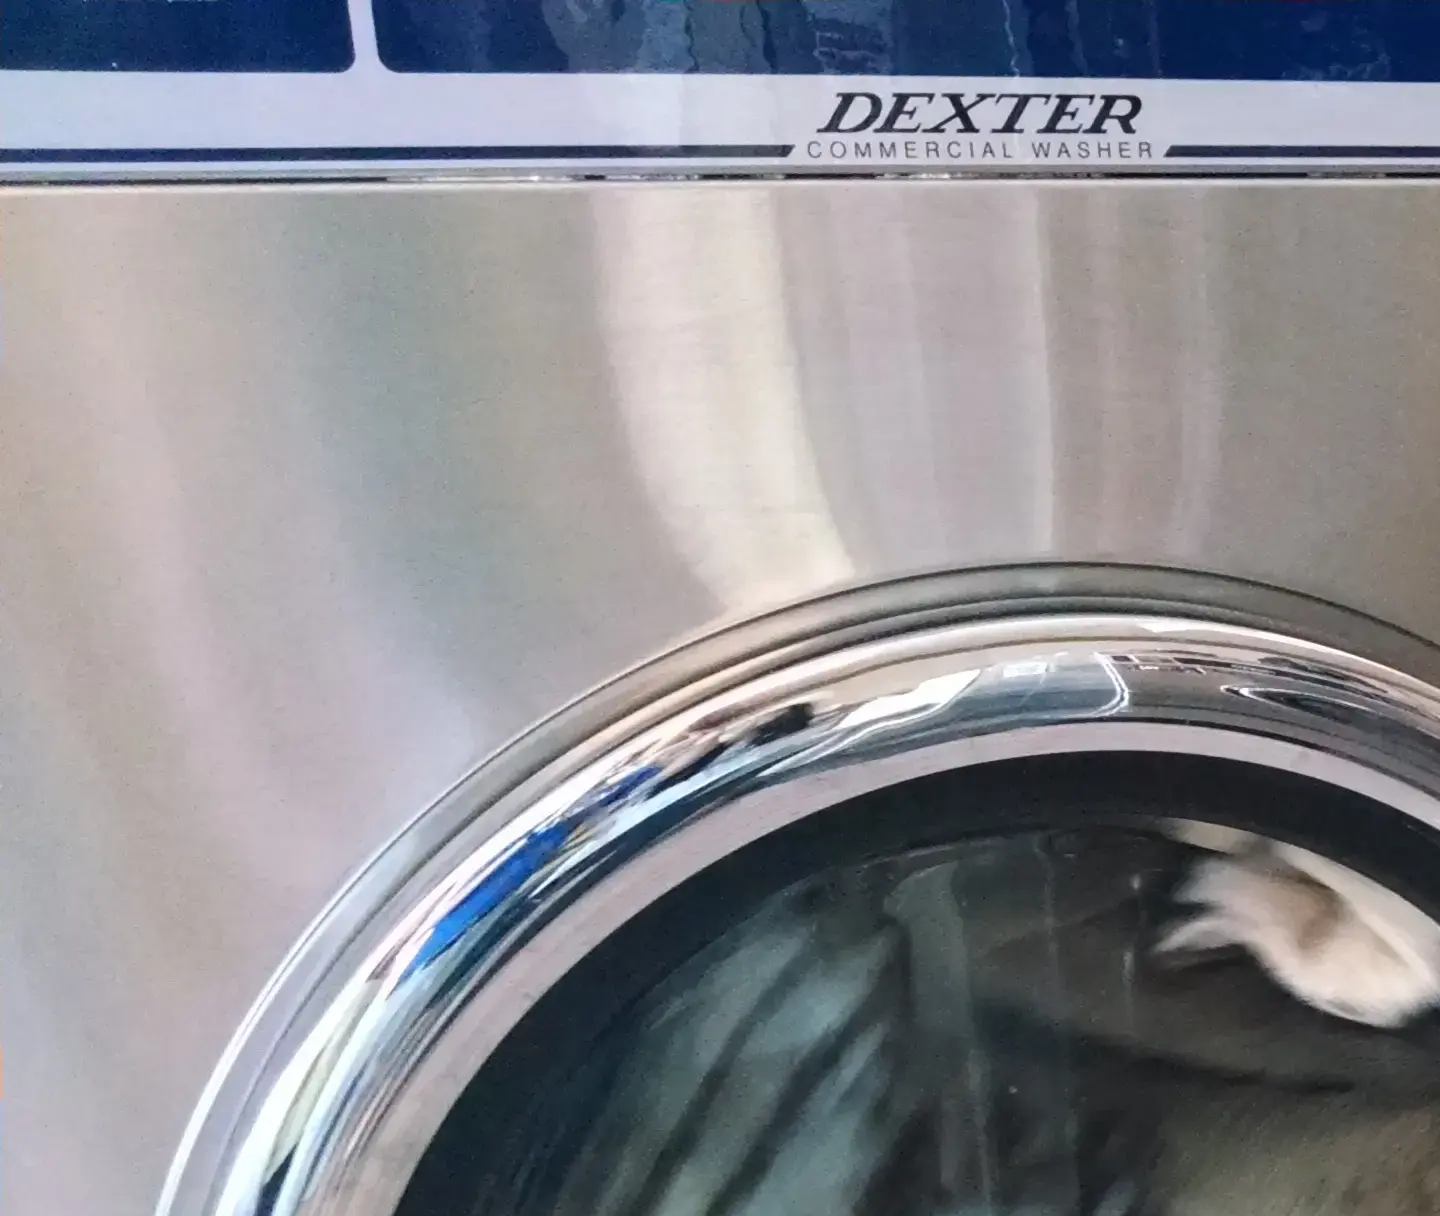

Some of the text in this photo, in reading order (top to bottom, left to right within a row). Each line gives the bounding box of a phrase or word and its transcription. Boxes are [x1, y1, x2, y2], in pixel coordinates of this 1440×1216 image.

[815, 91, 1144, 134] DEXTER
[806, 141, 1153, 159] COMMERCIAL WASHER
